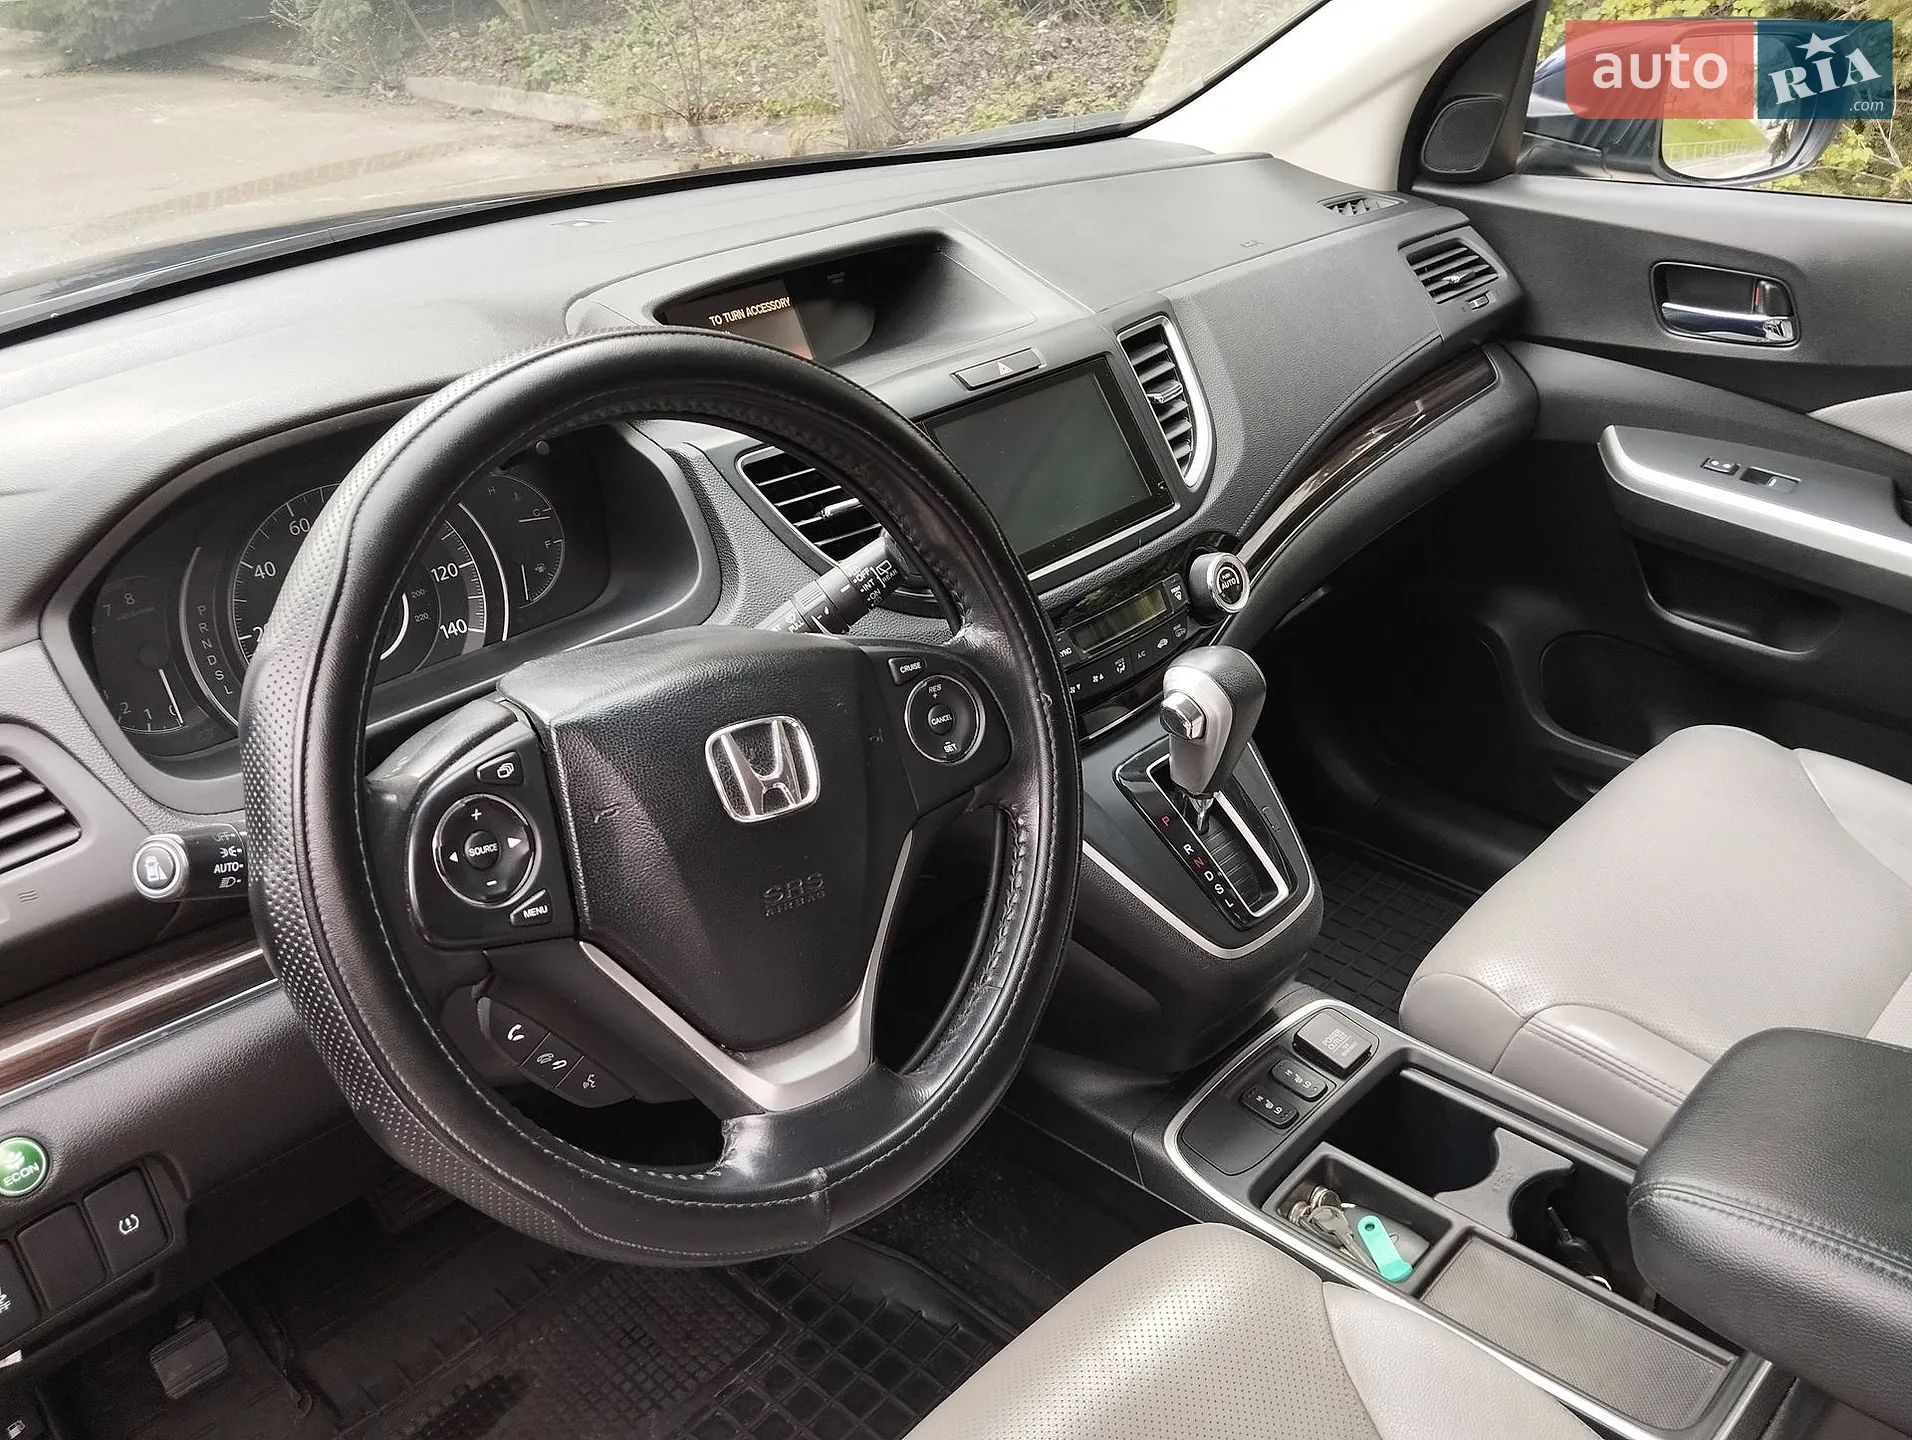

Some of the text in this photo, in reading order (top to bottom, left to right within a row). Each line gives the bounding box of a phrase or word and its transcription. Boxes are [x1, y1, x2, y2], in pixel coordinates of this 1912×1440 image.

[709, 296, 791, 327] TO TURN ACCESSORY
[289, 517, 311, 537] 60
[254, 560, 277, 580] 40
[430, 562, 459, 583] 120
[856, 567, 870, 582] OFF
[862, 578, 875, 592] INT
[1221, 577, 1237, 590] AUTO
[124, 592, 135, 605] 8
[102, 603, 111, 617] 7
[440, 618, 468, 639] 140
[197, 605, 233, 695] P R N D S L
[900, 661, 922, 674] CRUISE
[928, 683, 942, 694] RES
[121, 701, 131, 714] 2
[931, 713, 953, 726] CANCEL
[943, 742, 958, 753] SET
[468, 842, 499, 857] SOURCE
[213, 861, 241, 874] AUTO
[1161, 815, 1234, 908] P R N D S L
[523, 904, 549, 919] MENU
[2, 1161, 40, 1187] ECON
